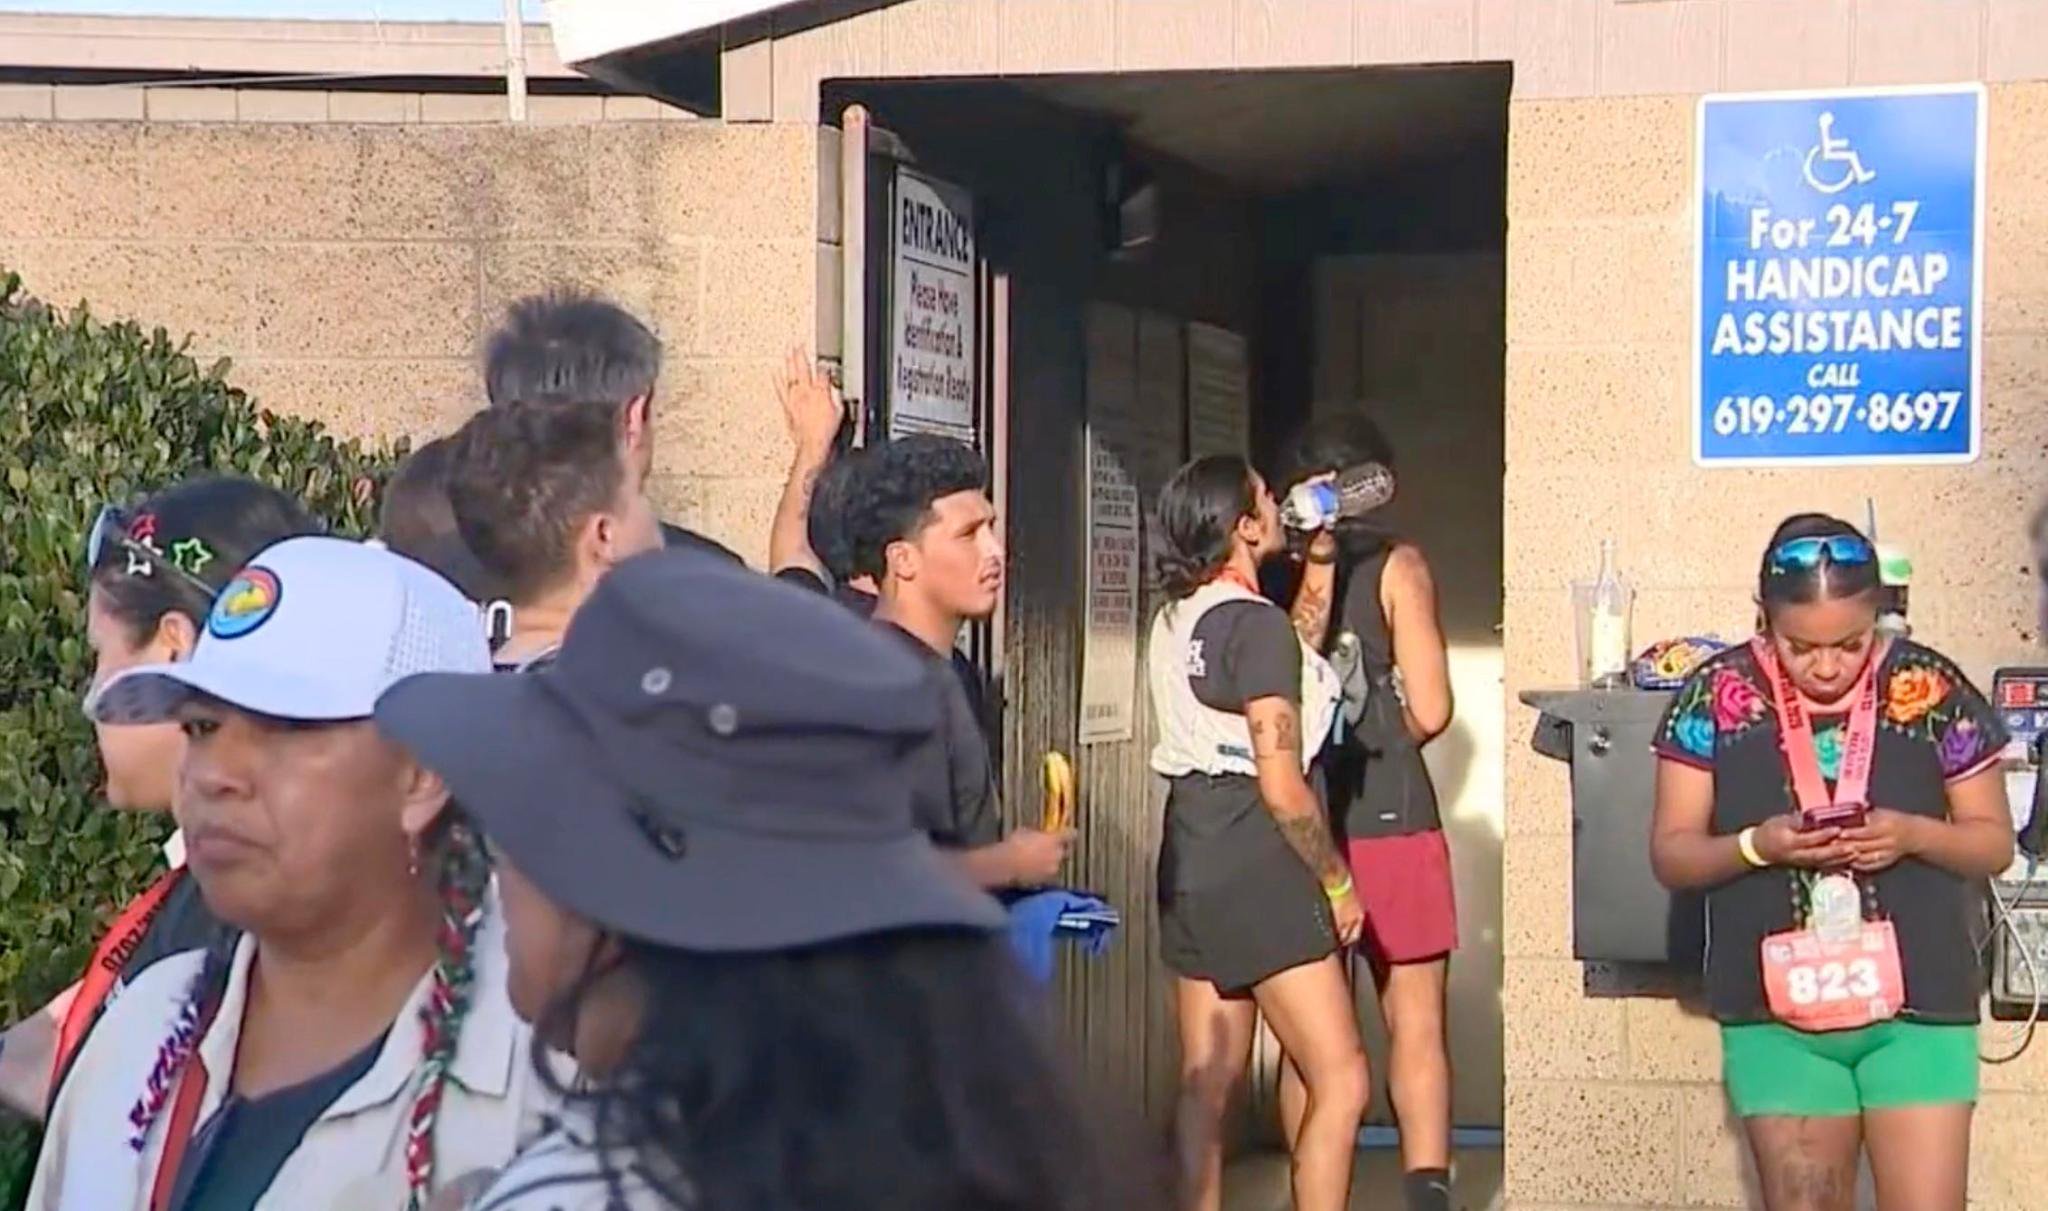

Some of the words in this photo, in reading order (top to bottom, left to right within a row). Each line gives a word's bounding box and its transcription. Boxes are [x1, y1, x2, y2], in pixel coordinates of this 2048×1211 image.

[903, 197, 968, 264] ENTRANCE
[1750, 208, 1815, 250] For
[1726, 253, 1949, 301] HANDICAP
[1711, 306, 1963, 356] ASSISTANCE
[1806, 363, 1861, 389] CALL
[1787, 957, 1880, 1005] 823
